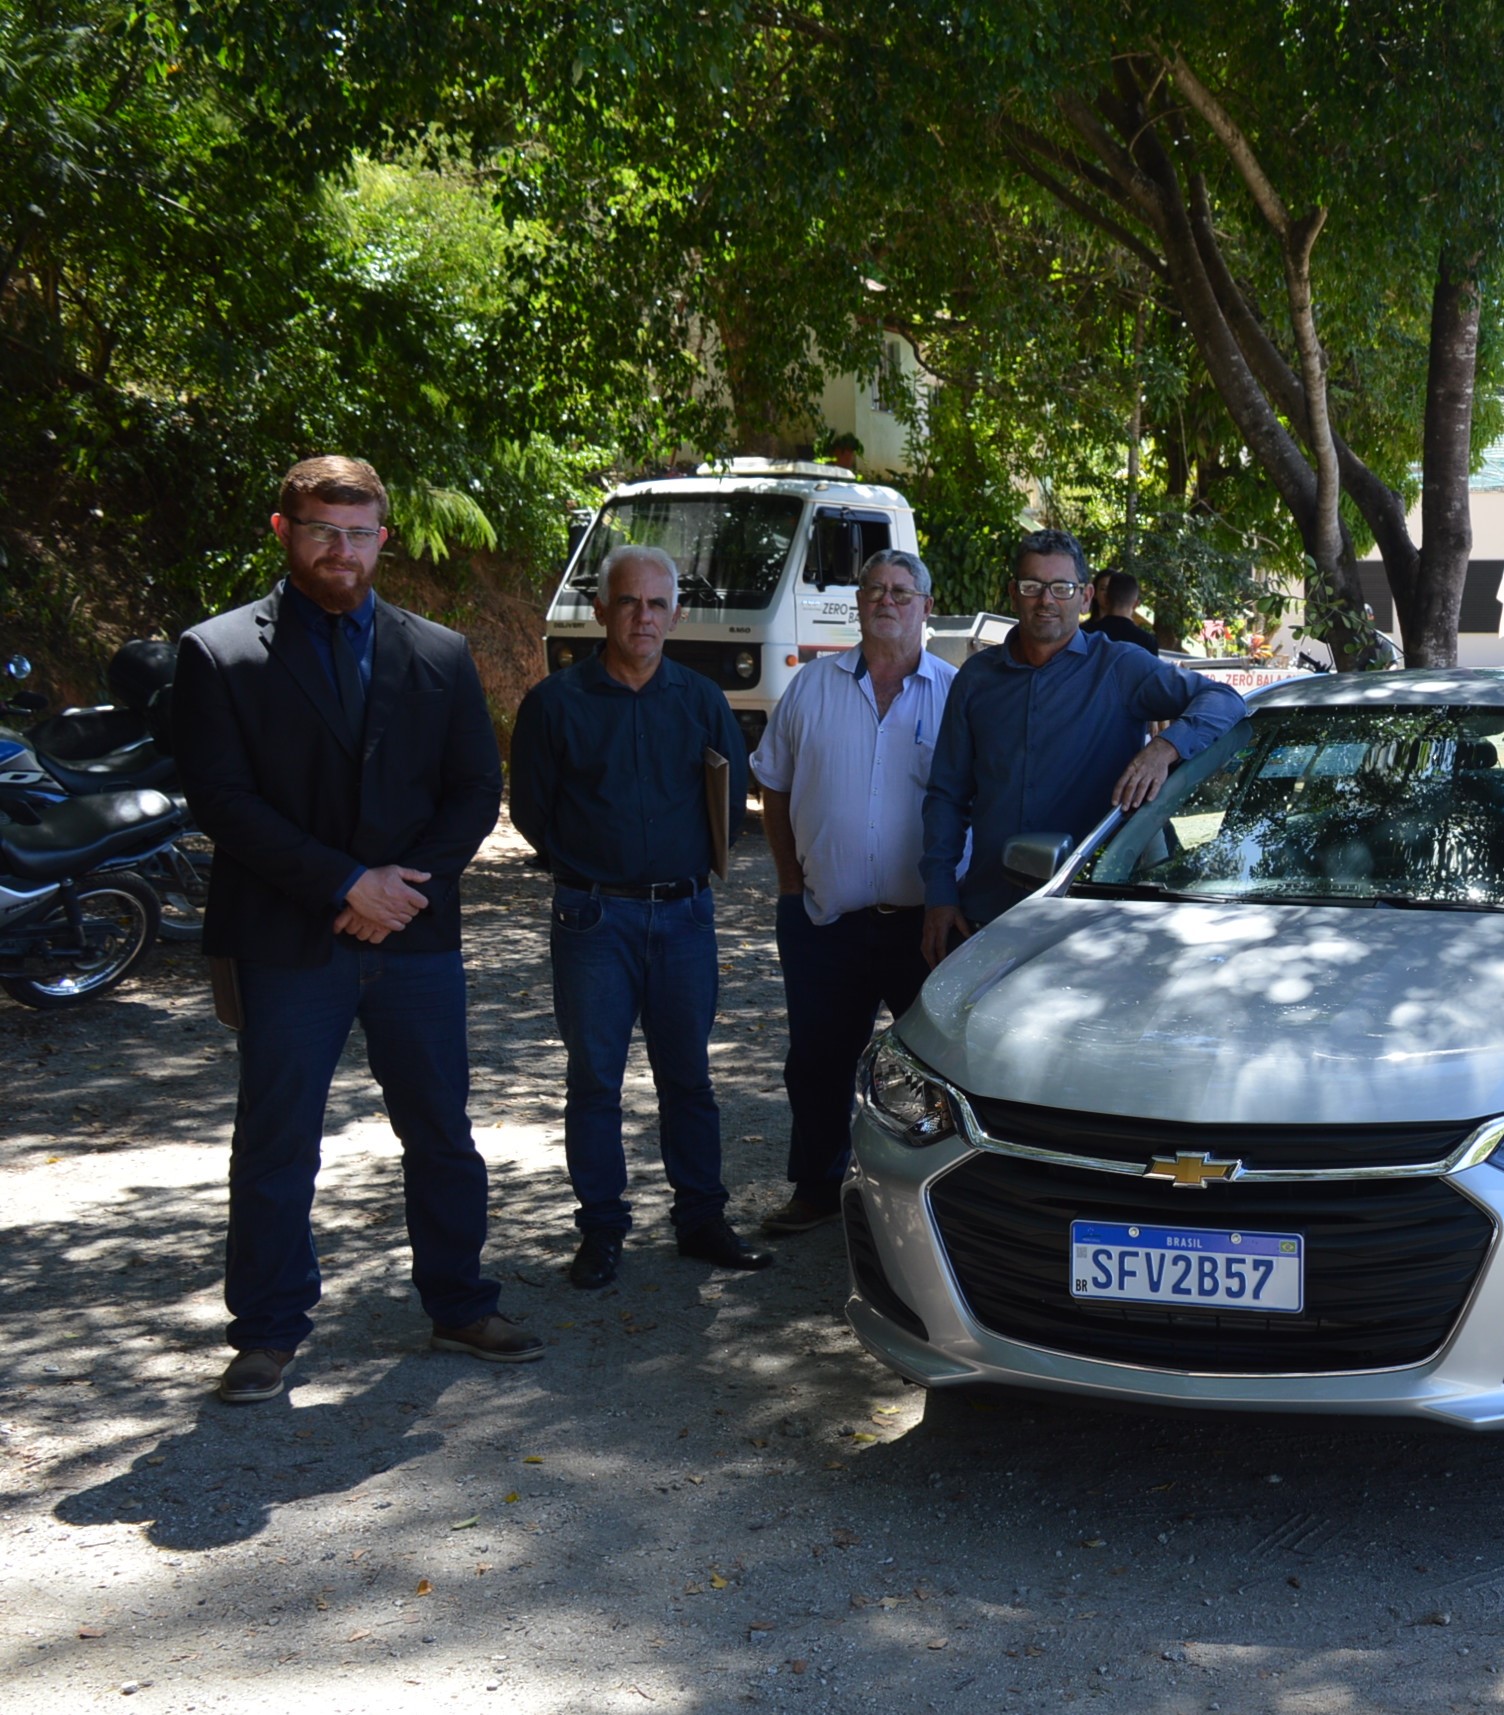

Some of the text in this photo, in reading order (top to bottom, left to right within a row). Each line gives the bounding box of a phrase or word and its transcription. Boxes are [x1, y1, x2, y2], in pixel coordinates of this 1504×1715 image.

[822, 602, 848, 615] ZERO
[1225, 674, 1254, 687] ZERO
[1166, 1236, 1203, 1249] BRASIL
[1091, 1249, 1275, 1301] SFV2B57
[1075, 1278, 1088, 1293] BR
